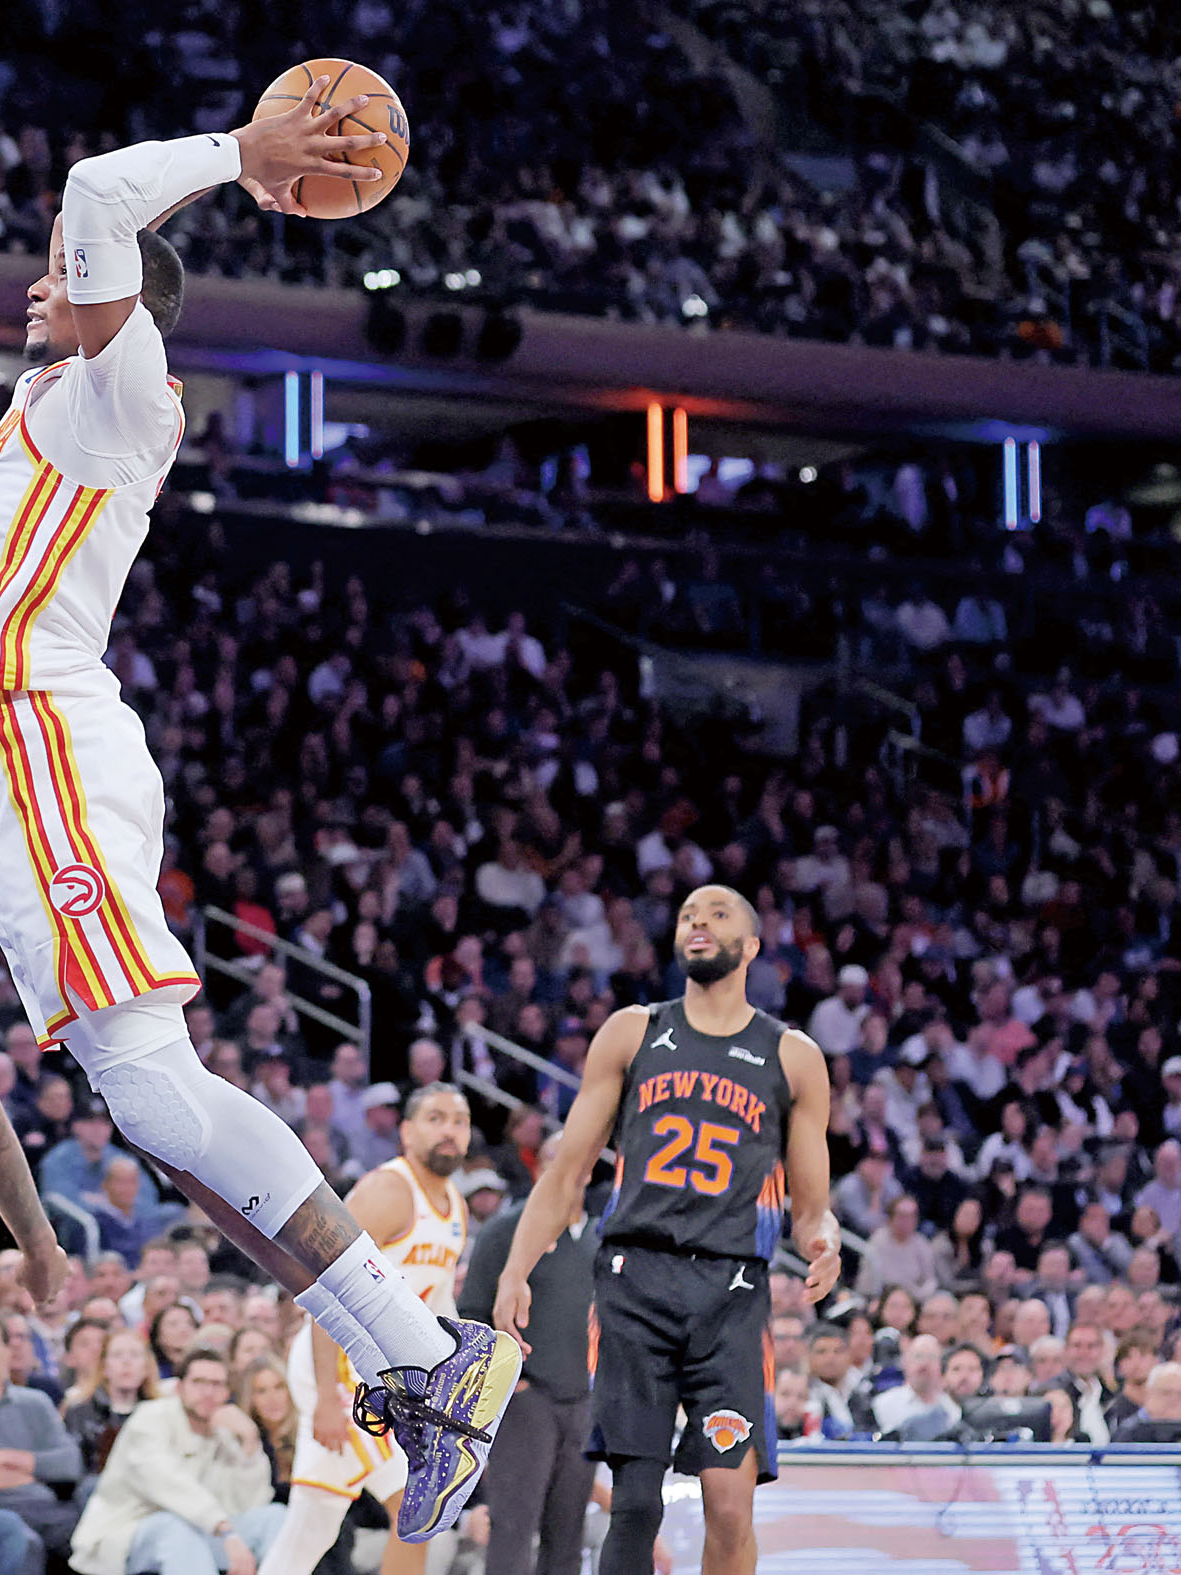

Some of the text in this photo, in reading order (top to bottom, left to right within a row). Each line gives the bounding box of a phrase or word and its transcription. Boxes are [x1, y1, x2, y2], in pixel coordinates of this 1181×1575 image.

[638, 1070, 767, 1134] NEW YORK
[643, 1113, 742, 1197] 25
